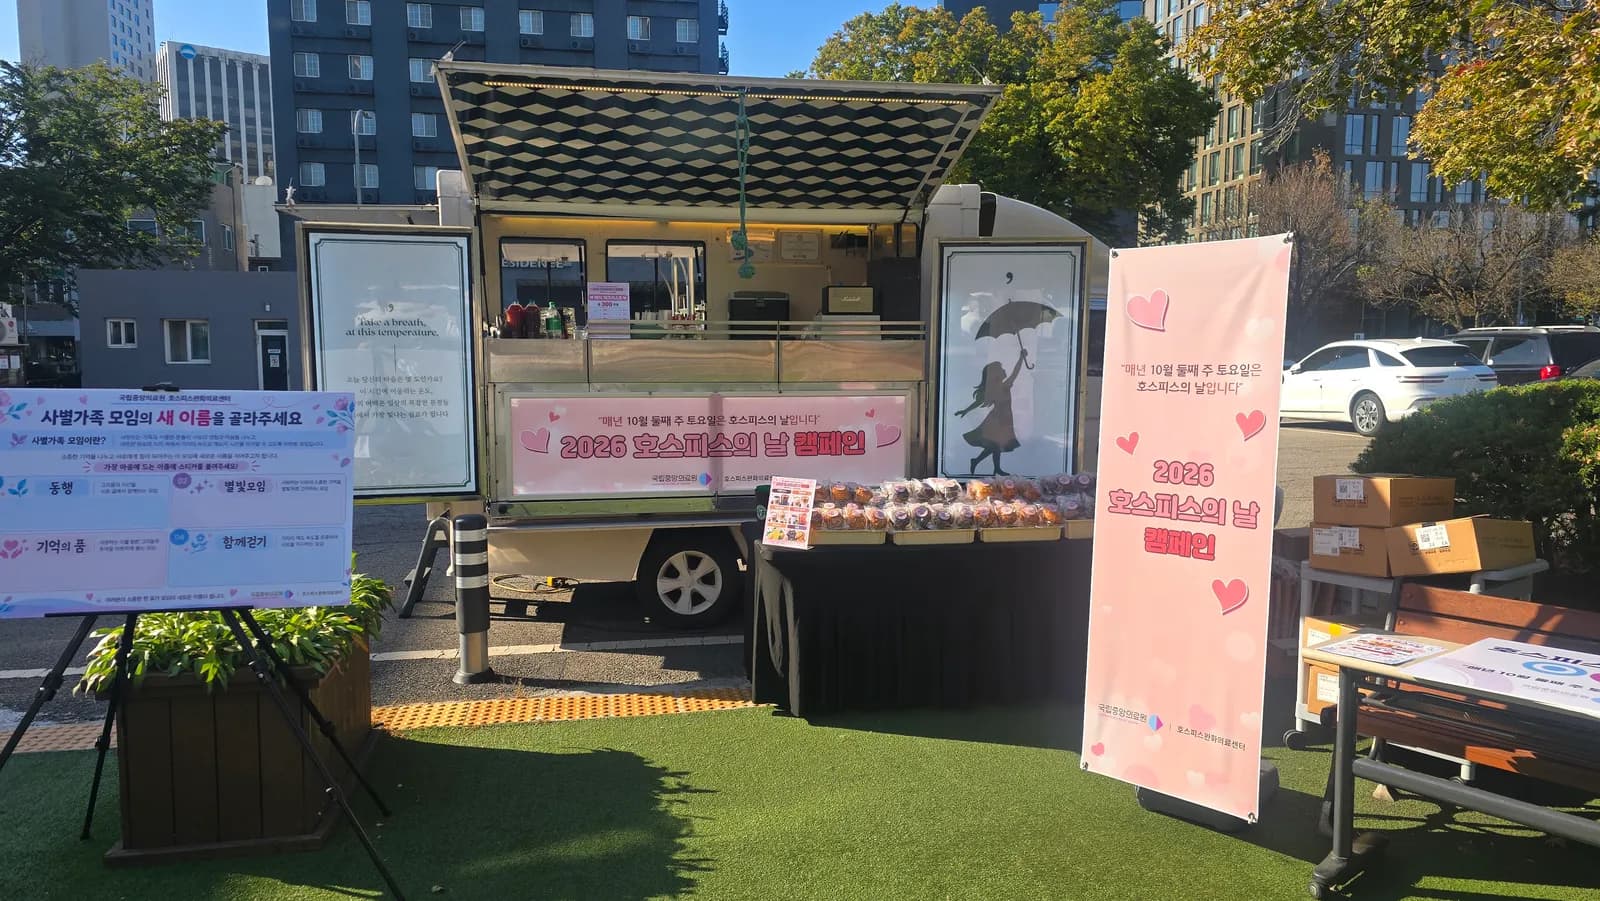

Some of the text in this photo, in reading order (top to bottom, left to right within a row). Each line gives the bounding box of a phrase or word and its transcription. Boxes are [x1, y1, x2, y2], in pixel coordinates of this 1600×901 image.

[391, 318, 426, 328] breath,
[345, 328, 440, 338] at this temperature.
[1151, 364, 1174, 377] 10월
[1176, 364, 1199, 377] 둘째
[1201, 364, 1214, 377] 주
[1216, 363, 1263, 377] 토요일은
[1136, 381, 1191, 394] 호스피스의
[41, 409, 303, 427] 사별가족 모임의 새 이름을 골라주세요
[627, 415, 648, 427] 10월
[651, 415, 672, 427] 둘째
[674, 415, 685, 427] 주
[686, 415, 726, 427] 토요일은
[728, 415, 777, 426] 호스피스의
[31, 435, 106, 446] 사별가족 모임이란?
[560, 429, 866, 459] 2026 호스피스의 날 캠페인
[1153, 459, 1215, 487] 2026
[49, 481, 73, 495] 동행
[224, 480, 266, 493] 별빛모임
[1108, 488, 1261, 530] 호스피스의 날
[36, 540, 71, 554] 기억의
[223, 536, 267, 549] 함께걷기
[1144, 526, 1216, 562] 캠페인
[1097, 703, 1147, 723] 국립중앙의료원
[1176, 725, 1246, 751] 호스피스완화의료센터
